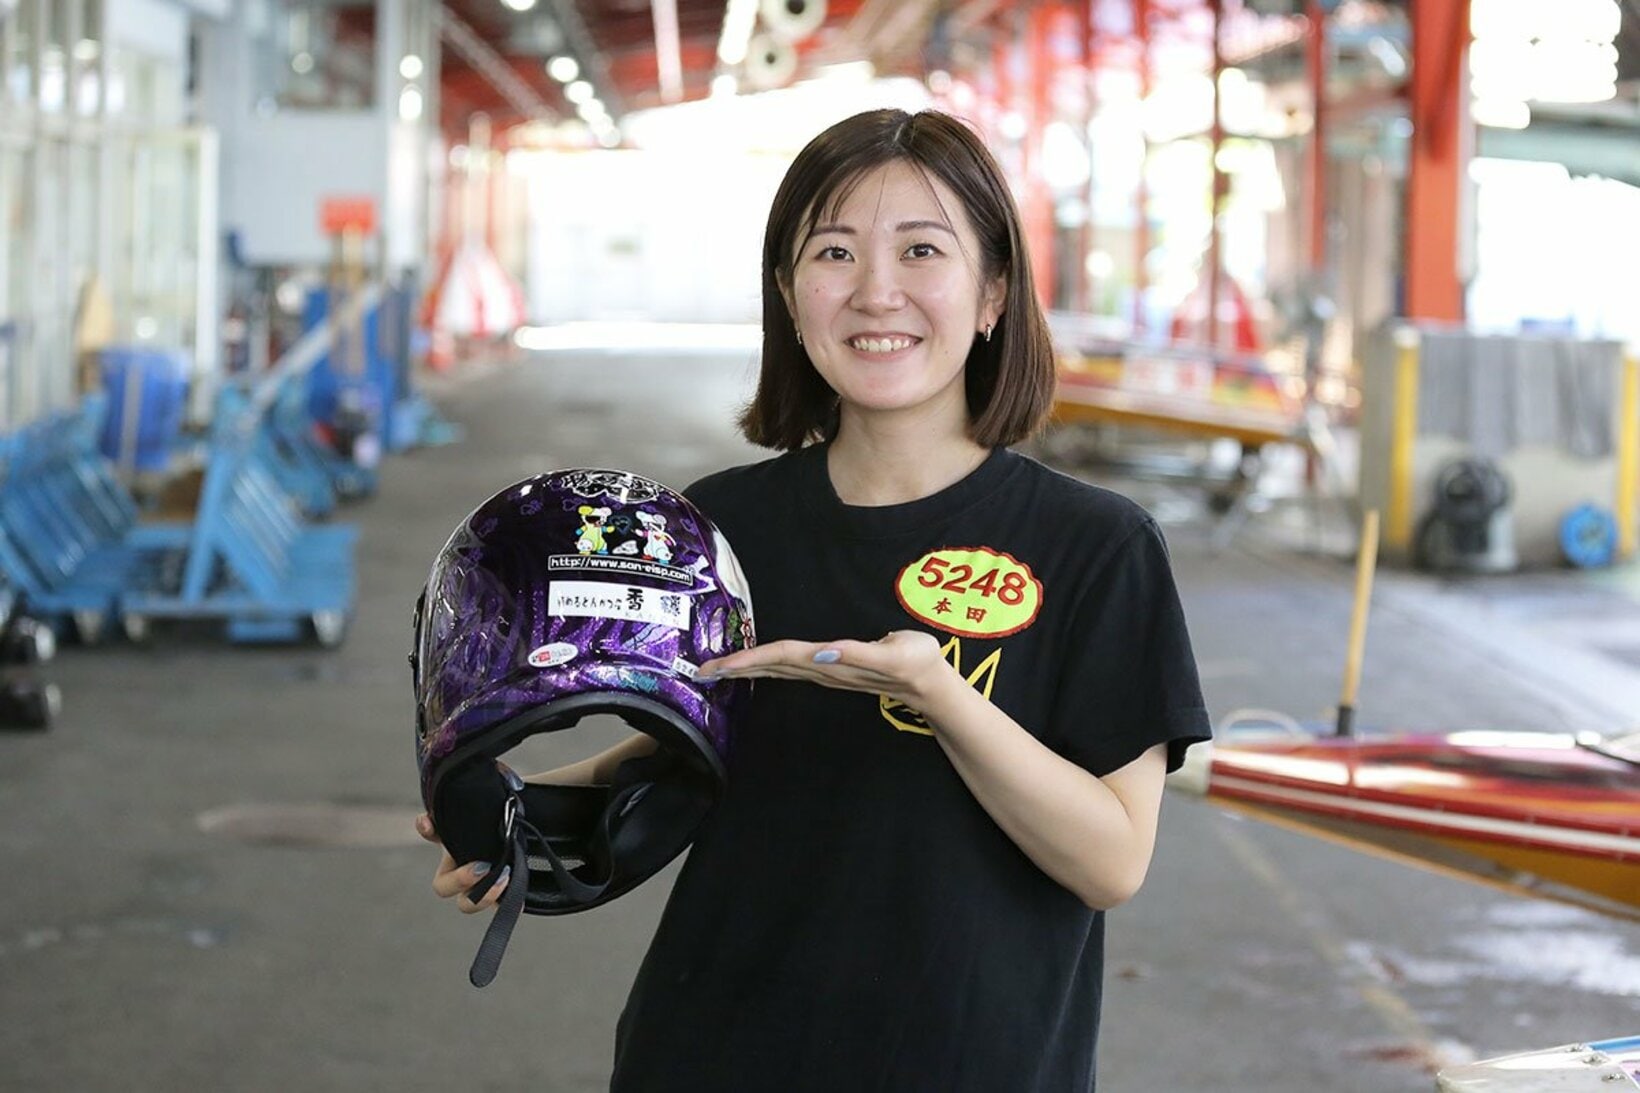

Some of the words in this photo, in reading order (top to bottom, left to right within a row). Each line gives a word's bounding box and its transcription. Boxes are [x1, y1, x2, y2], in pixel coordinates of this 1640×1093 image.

[550, 557, 690, 581] http://www.san-eisp.com
[917, 556, 1027, 606] 5248
[932, 597, 988, 623] 本田
